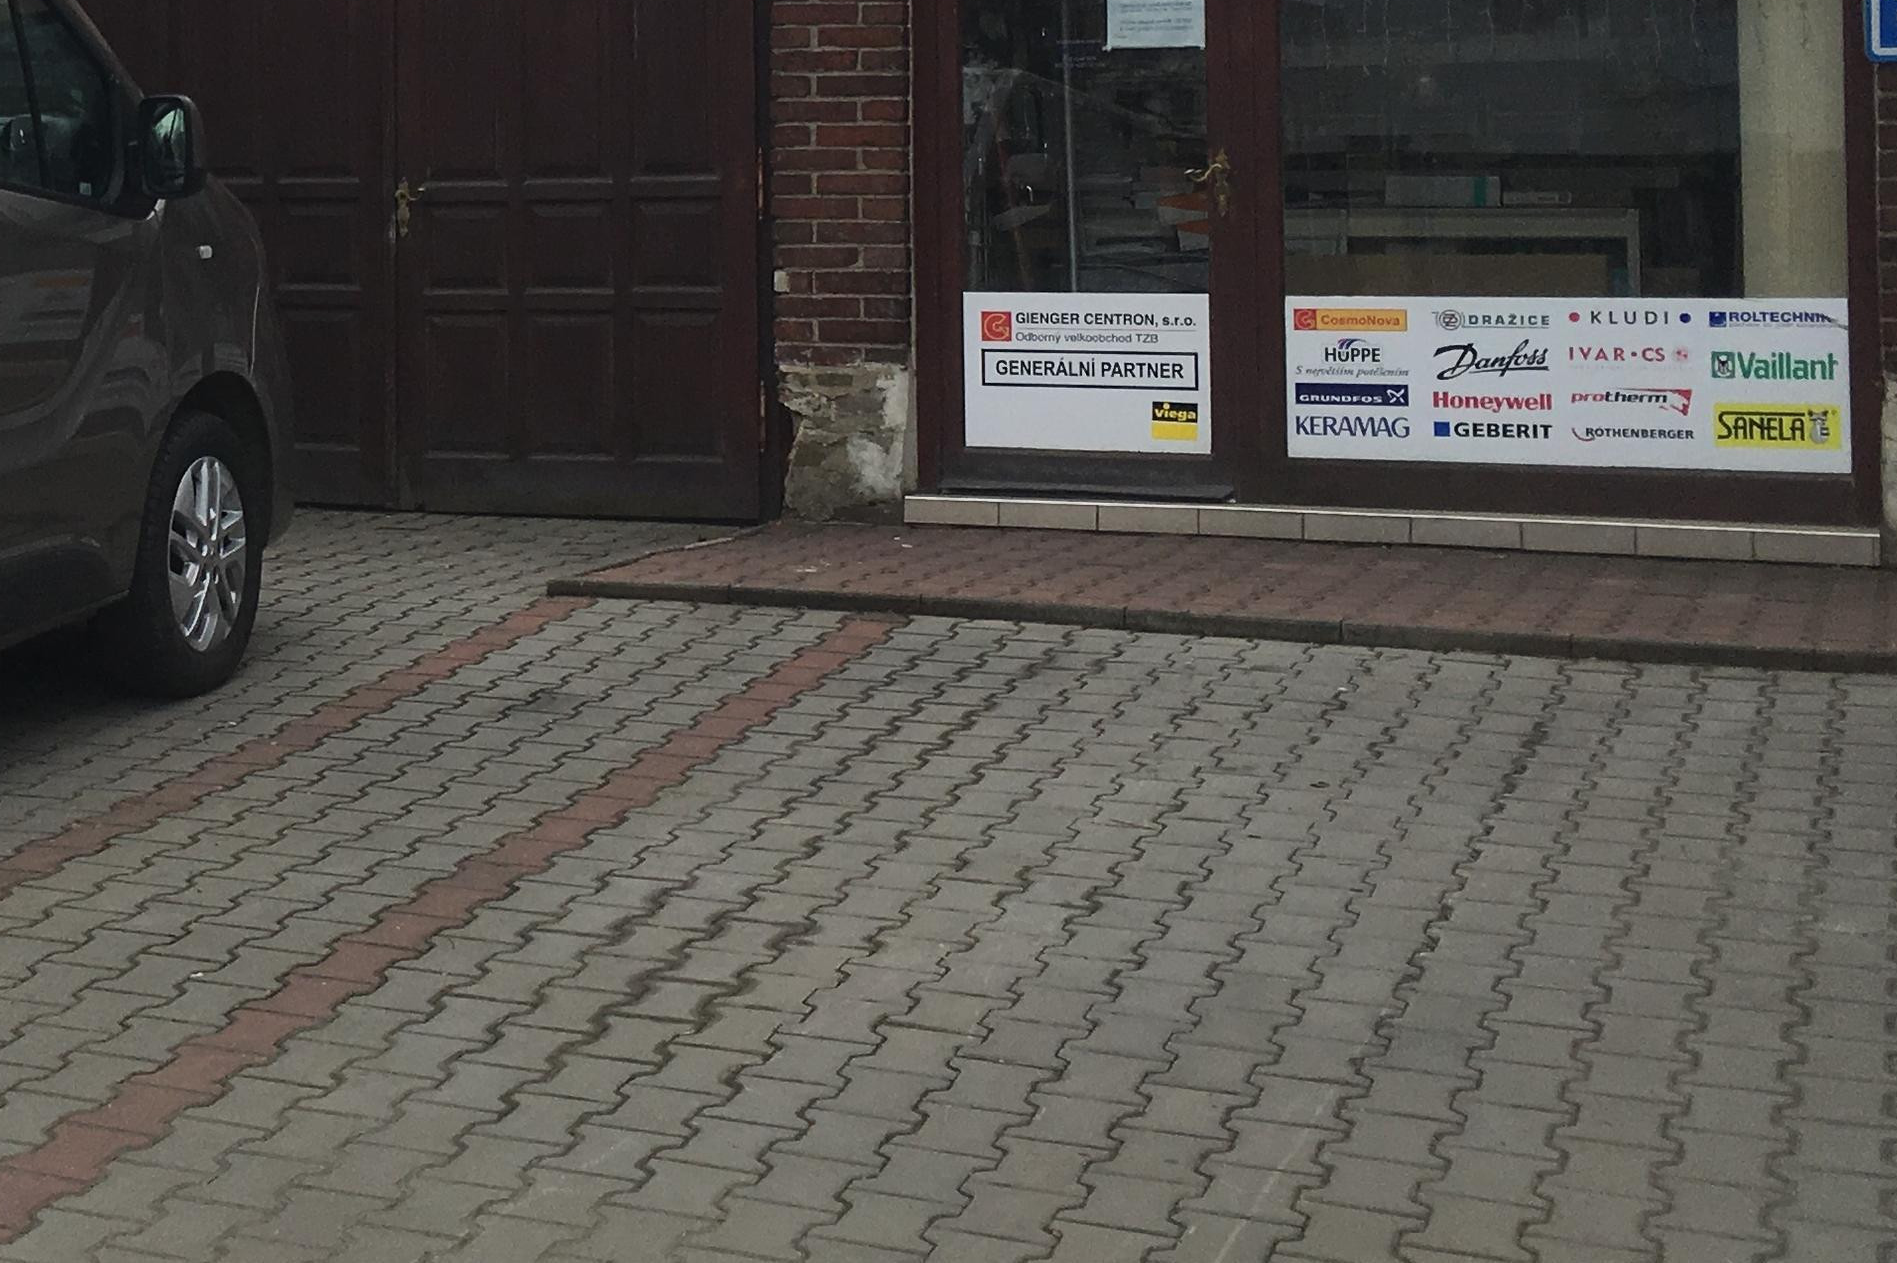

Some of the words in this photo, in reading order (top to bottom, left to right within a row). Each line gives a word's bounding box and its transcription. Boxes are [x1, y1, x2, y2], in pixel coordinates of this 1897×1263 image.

[1015, 312, 1080, 325] GIENGER
[1084, 313, 1159, 327] CENTRON,
[1162, 316, 1196, 326] s.r.o.
[1320, 314, 1401, 326] CosmoNova
[1468, 313, 1550, 326] DRAŽICE
[1590, 311, 1670, 325] KLUDI
[1015, 332, 1061, 344] Odborný
[1135, 334, 1159, 343] TZB
[1433, 339, 1549, 380] Danfoss
[1737, 351, 1838, 380] Vaillant
[995, 357, 1095, 377] GENERÁLNÍ
[1101, 362, 1184, 379] PARTNER
[1299, 394, 1383, 403] GRUNDFOS
[1432, 391, 1552, 413] Honeywell
[1571, 391, 1667, 403] protherm
[1155, 403, 1196, 421] viega
[1295, 415, 1410, 438] KERAMAG
[1454, 422, 1553, 439] GEBERIT
[1585, 427, 1694, 439] ROTHENBERGER
[1717, 411, 1805, 441] SANELA
